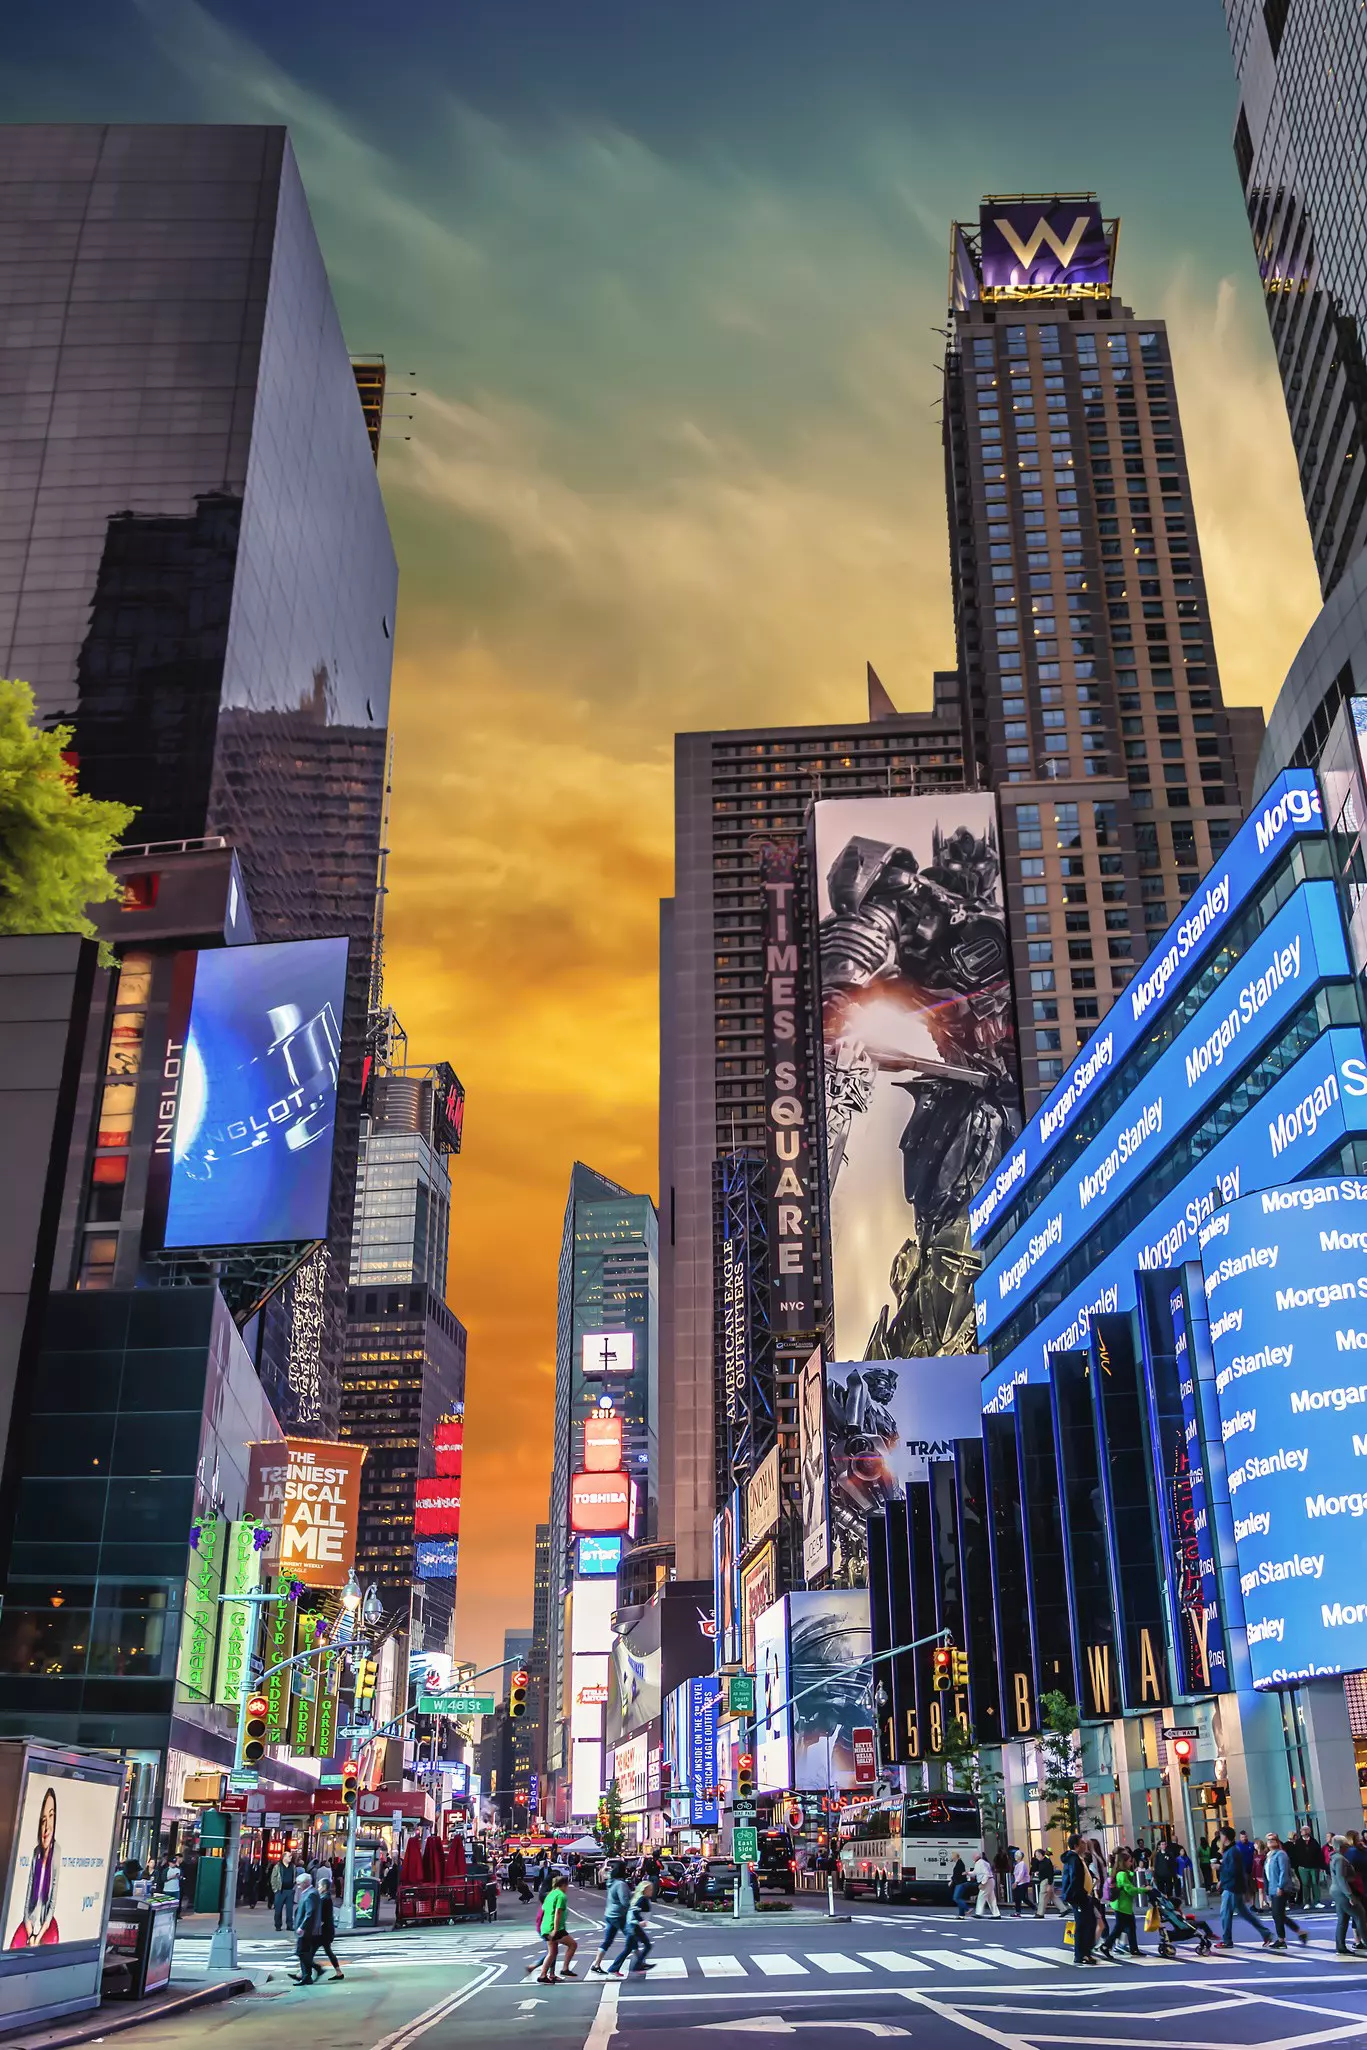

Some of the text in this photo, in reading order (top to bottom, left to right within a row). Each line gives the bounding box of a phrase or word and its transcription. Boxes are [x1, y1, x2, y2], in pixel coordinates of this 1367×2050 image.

[993, 217, 1090, 270] W
[765, 882, 800, 1041] TIMES
[1131, 874, 1230, 1021] Morgan Stanley
[1185, 935, 1301, 1088] Morgan Stanley
[154, 1038, 184, 1154] INGLOT
[1040, 1031, 1114, 1144] Morgan Stanley
[445, 1083, 465, 1137] H&M
[1269, 1073, 1339, 1158] Morgan
[773, 1061, 804, 1275] SQUARE
[1079, 1097, 1163, 1209] Morgan Stanley
[970, 1148, 1027, 1237] Morgan Stanley
[1261, 1185, 1339, 1214] Morgan
[999, 1212, 1063, 1299] Morgan Stanley
[1219, 1245, 1279, 1283] Stanley
[780, 1301, 805, 1312] NYC
[1275, 1282, 1357, 1312] Morgan
[723, 1238, 736, 1420] AMERICAN EAGLE
[735, 1261, 746, 1389] OUTFITTERS
[1231, 1343, 1294, 1383] Stanley
[592, 1409, 616, 1419] 2017
[288, 1451, 316, 1465] THE
[1245, 1448, 1309, 1482] Stanley
[291, 1502, 345, 1528] ALL
[574, 1492, 627, 1504] TOSHIBA
[1258, 1553, 1325, 1583] Stanley
[224, 1529, 253, 1701] OLIVE GARDEN
[273, 1581, 290, 1646] OLIVE
[433, 1700, 481, 1710] W 48 St
[694, 1683, 703, 1704] LEVEL
[319, 1700, 332, 1756] GARDEN
[694, 1718, 703, 1733] THE
[694, 1734, 703, 1744] ON
[694, 1745, 703, 1772] INSIDE
[704, 1736, 713, 1760] EAGLE
[694, 1799, 704, 1820] VISIT
